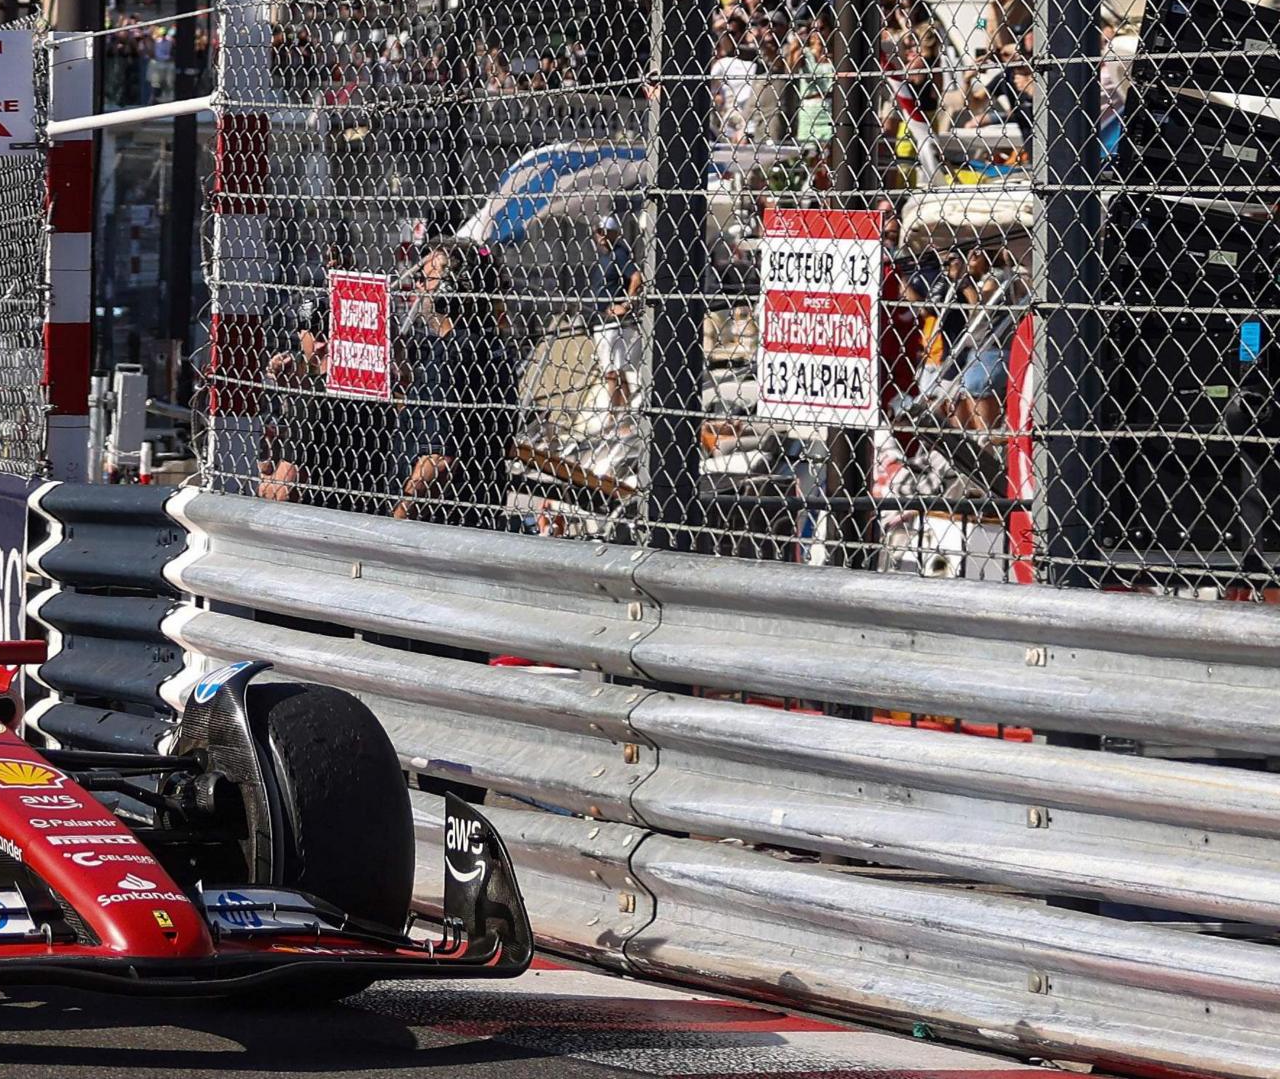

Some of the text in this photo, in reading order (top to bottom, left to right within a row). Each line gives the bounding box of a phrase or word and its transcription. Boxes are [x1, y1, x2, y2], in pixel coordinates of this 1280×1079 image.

[769, 251, 870, 287] SECTEUR 13
[803, 297, 831, 309] POSTE
[767, 311, 868, 349] INTERVENTION
[767, 362, 864, 400] 13 ALPHA
[19, 795, 78, 806] aws
[49, 819, 116, 827] Palantir
[46, 835, 137, 845] PIRELLI
[447, 815, 484, 855] aws
[99, 854, 154, 863] CELSIUS
